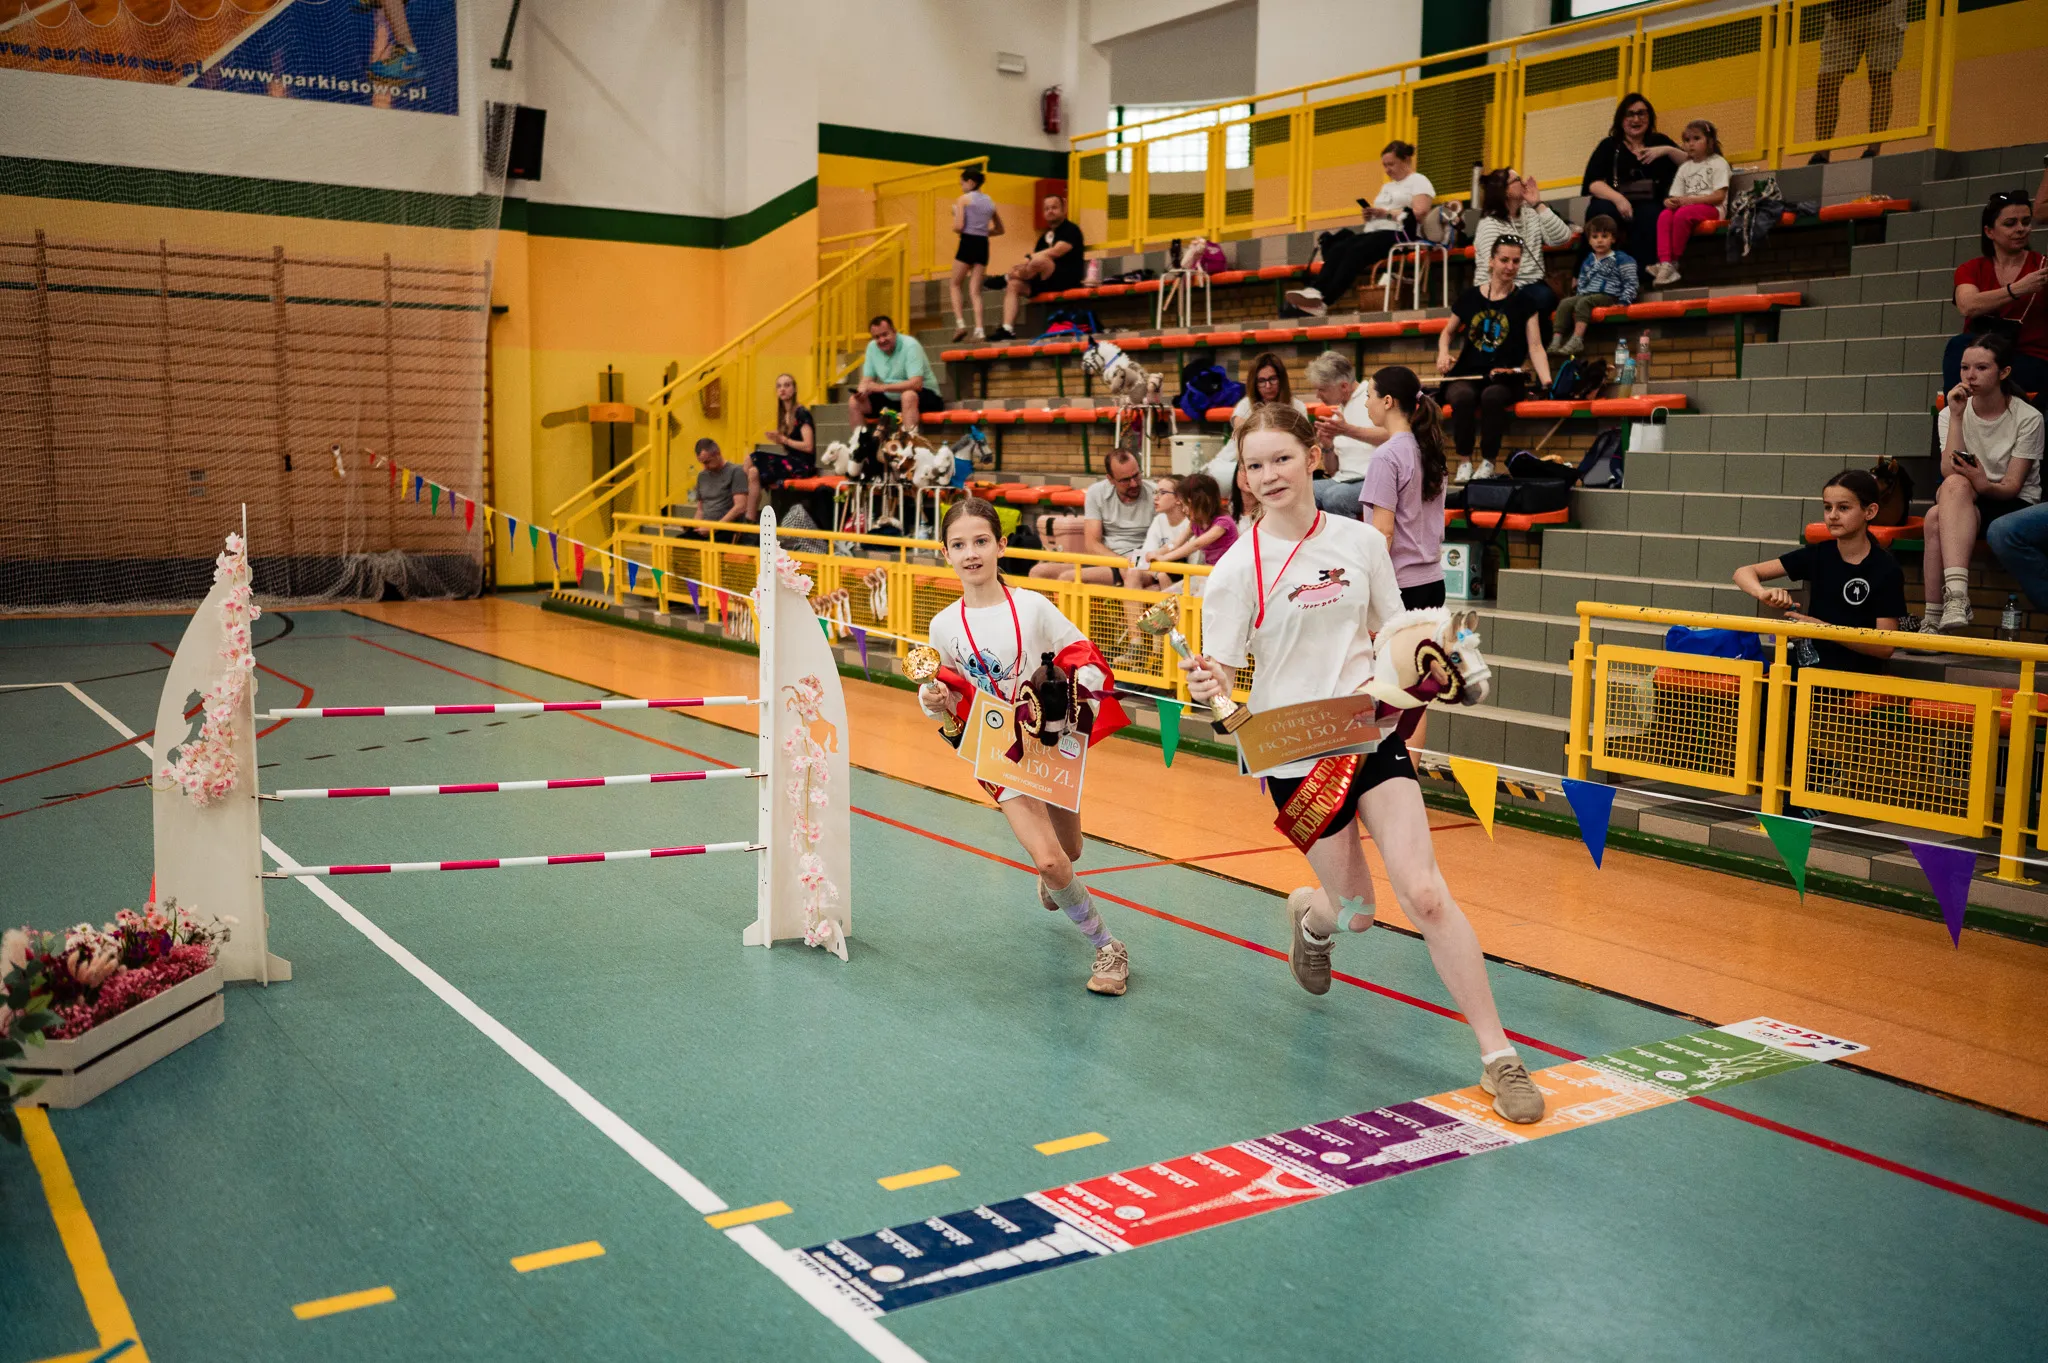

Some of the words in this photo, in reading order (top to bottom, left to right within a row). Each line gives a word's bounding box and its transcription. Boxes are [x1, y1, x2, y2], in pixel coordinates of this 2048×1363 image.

[219, 66, 428, 100] www.parkietowo.pl
[1321, 597, 1339, 607] DOG
[1258, 732, 1301, 753] BON
[1306, 724, 1338, 740] 150
[1026, 758, 1049, 779] 150
[1313, 758, 1336, 782] CLUB
[1285, 777, 1321, 819] 30.05.2026
[1374, 1109, 1393, 1119] CM
[1339, 1118, 1359, 1127] CM
[1394, 1117, 1419, 1129] 110
[1301, 1126, 1321, 1136] CM
[1358, 1126, 1384, 1138] 120
[1265, 1136, 1285, 1146] CM
[1321, 1134, 1347, 1147] 130
